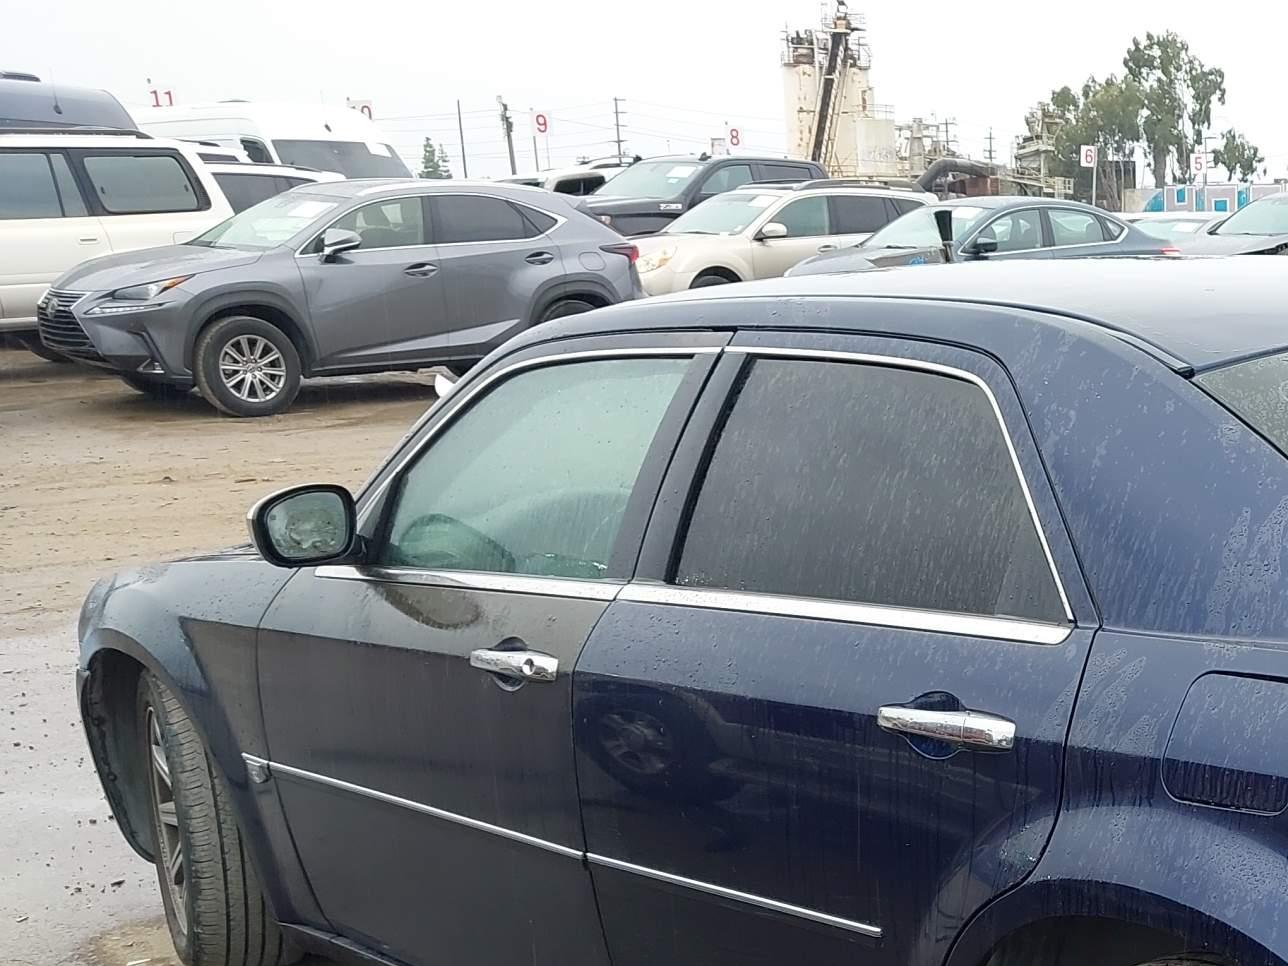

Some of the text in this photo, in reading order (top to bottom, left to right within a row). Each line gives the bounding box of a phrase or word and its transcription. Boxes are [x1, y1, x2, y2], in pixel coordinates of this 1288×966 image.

[149, 89, 174, 108] 11
[535, 113, 548, 133] 9
[729, 128, 740, 146] 8
[1085, 148, 1094, 164] 6
[1194, 156, 1203, 172] 5
